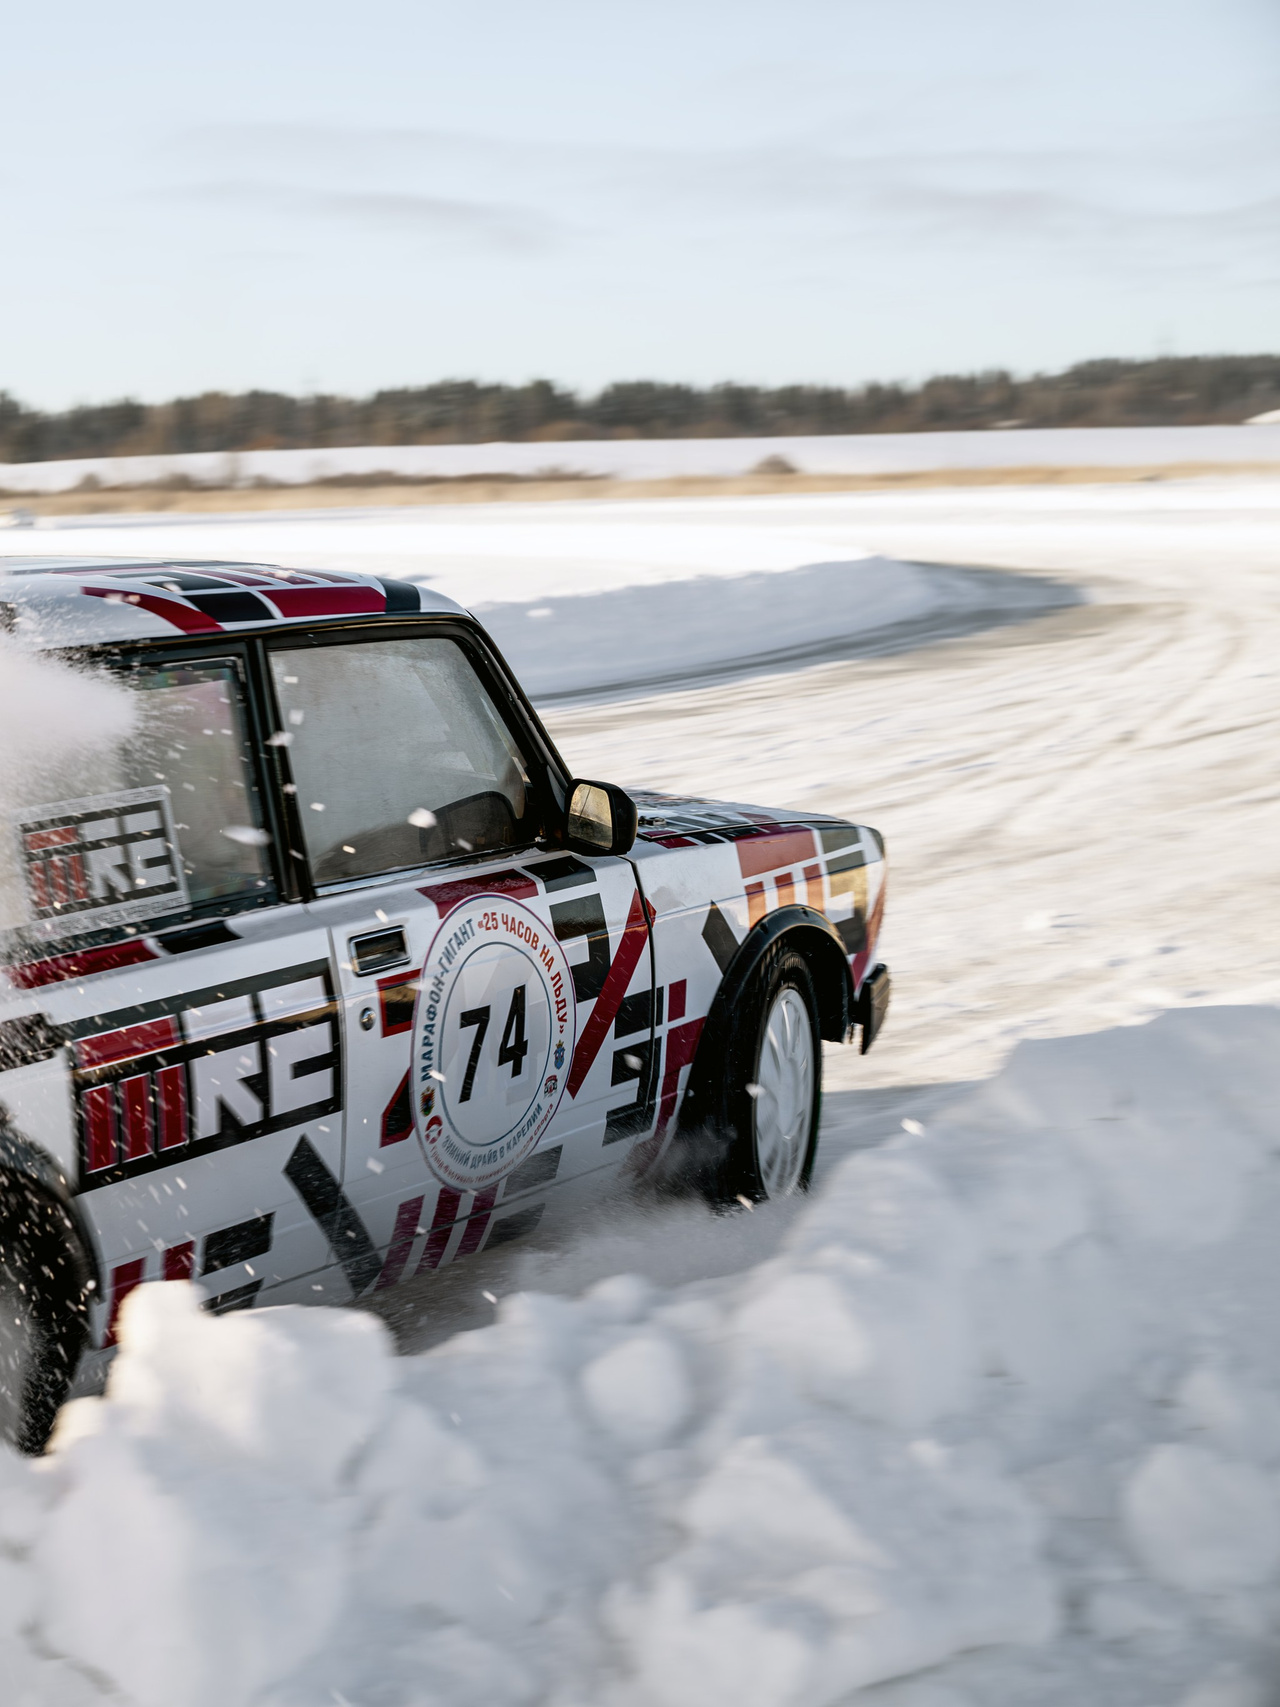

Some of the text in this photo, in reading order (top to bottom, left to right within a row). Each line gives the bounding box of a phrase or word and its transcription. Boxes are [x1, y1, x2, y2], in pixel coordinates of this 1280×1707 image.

[421, 912, 568, 1083] МАРАФОН-ГИГАНТ «25 ЧАСОВ НА ЛЬДУ»
[459, 984, 529, 1104] 74
[469, 1149, 498, 1170] ДРАЙВ
[499, 1145, 506, 1160] В
[506, 1102, 543, 1154] КАРЕЛИИ
